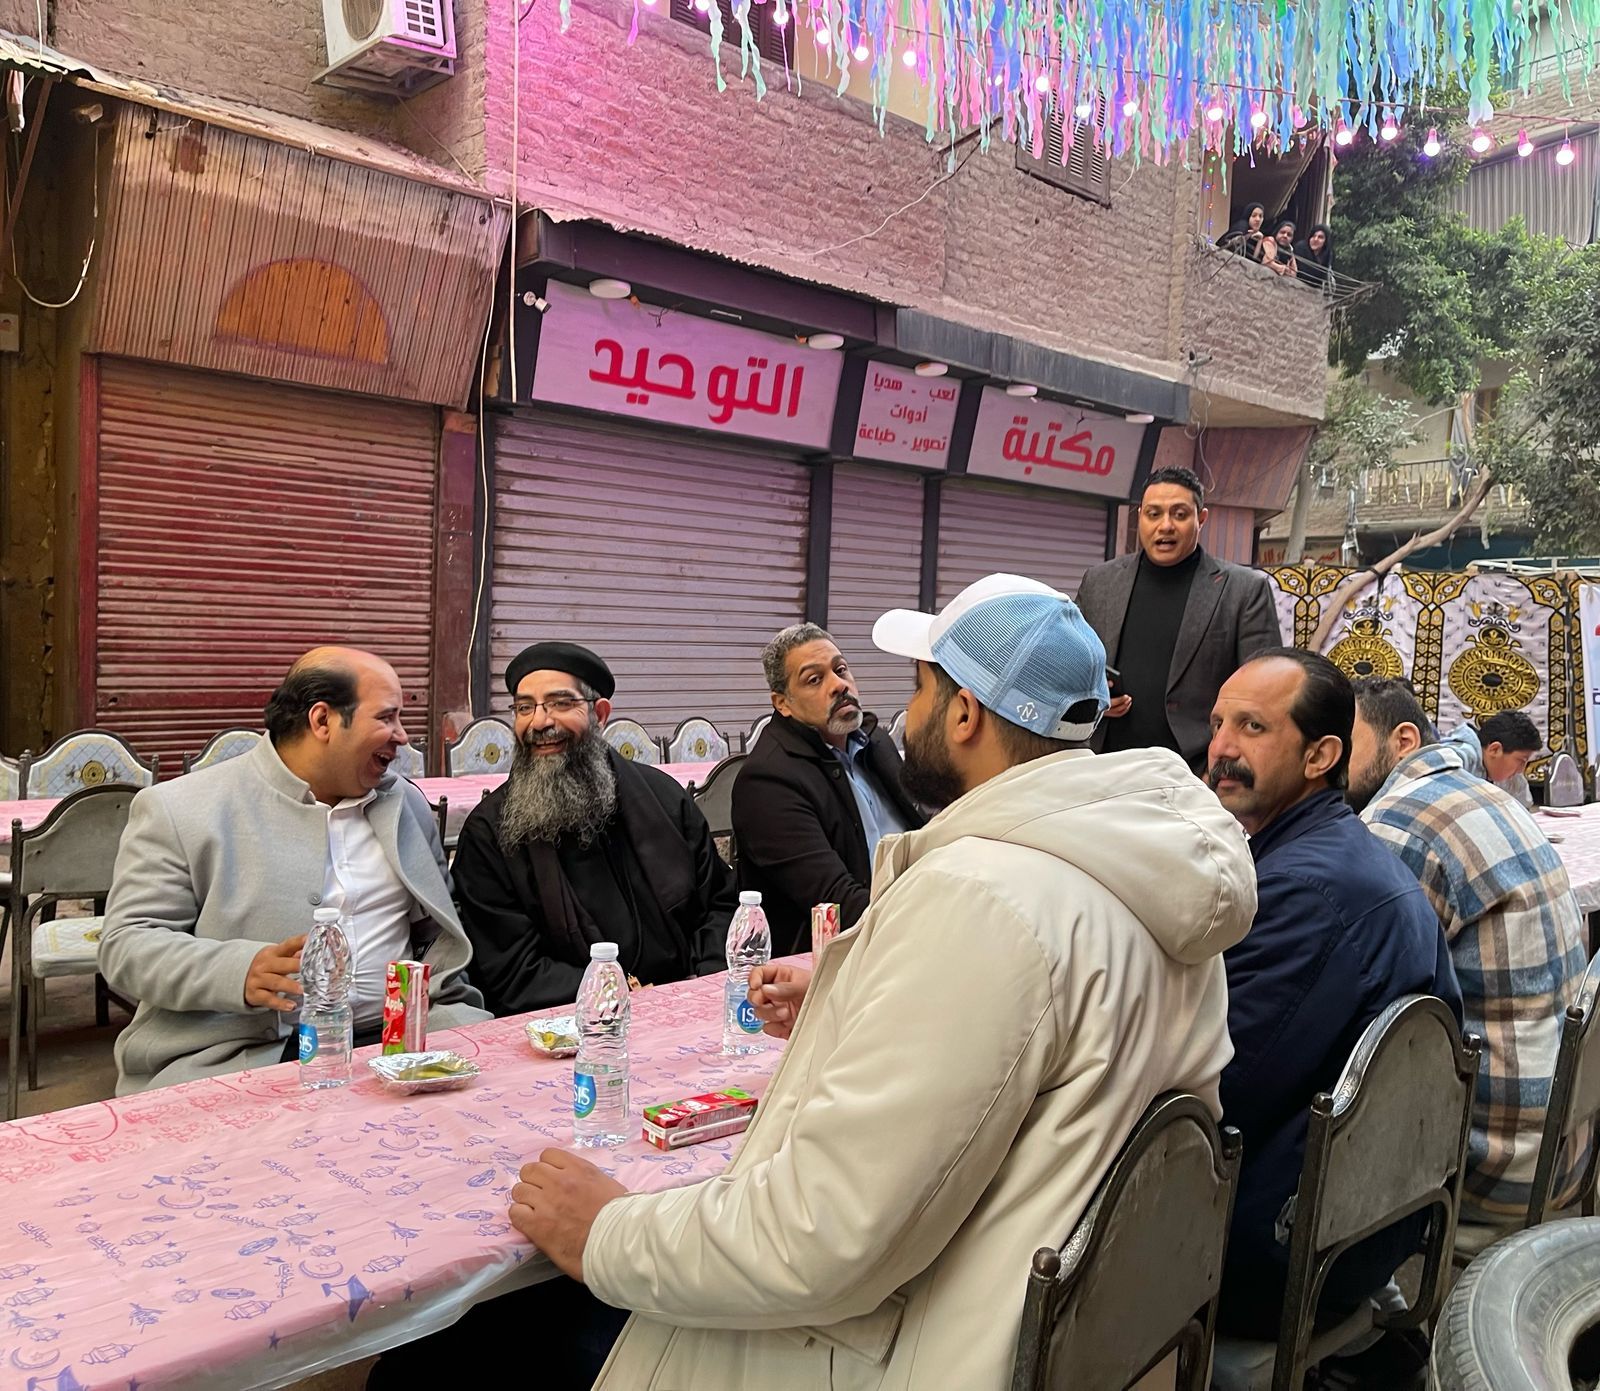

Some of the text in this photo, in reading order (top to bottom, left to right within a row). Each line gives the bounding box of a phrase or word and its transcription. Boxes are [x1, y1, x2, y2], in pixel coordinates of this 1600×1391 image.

[589, 338, 804, 424] التوحيد
[873, 372, 903, 392] هديا
[929, 387, 956, 402] لعب
[890, 404, 928, 424] أدوات
[858, 423, 896, 446] طباعة
[911, 436, 947, 452] تصوير
[1002, 415, 1116, 477] مكتبة
[385, 995, 404, 1012] Apple
[741, 1007, 761, 1023] IS
